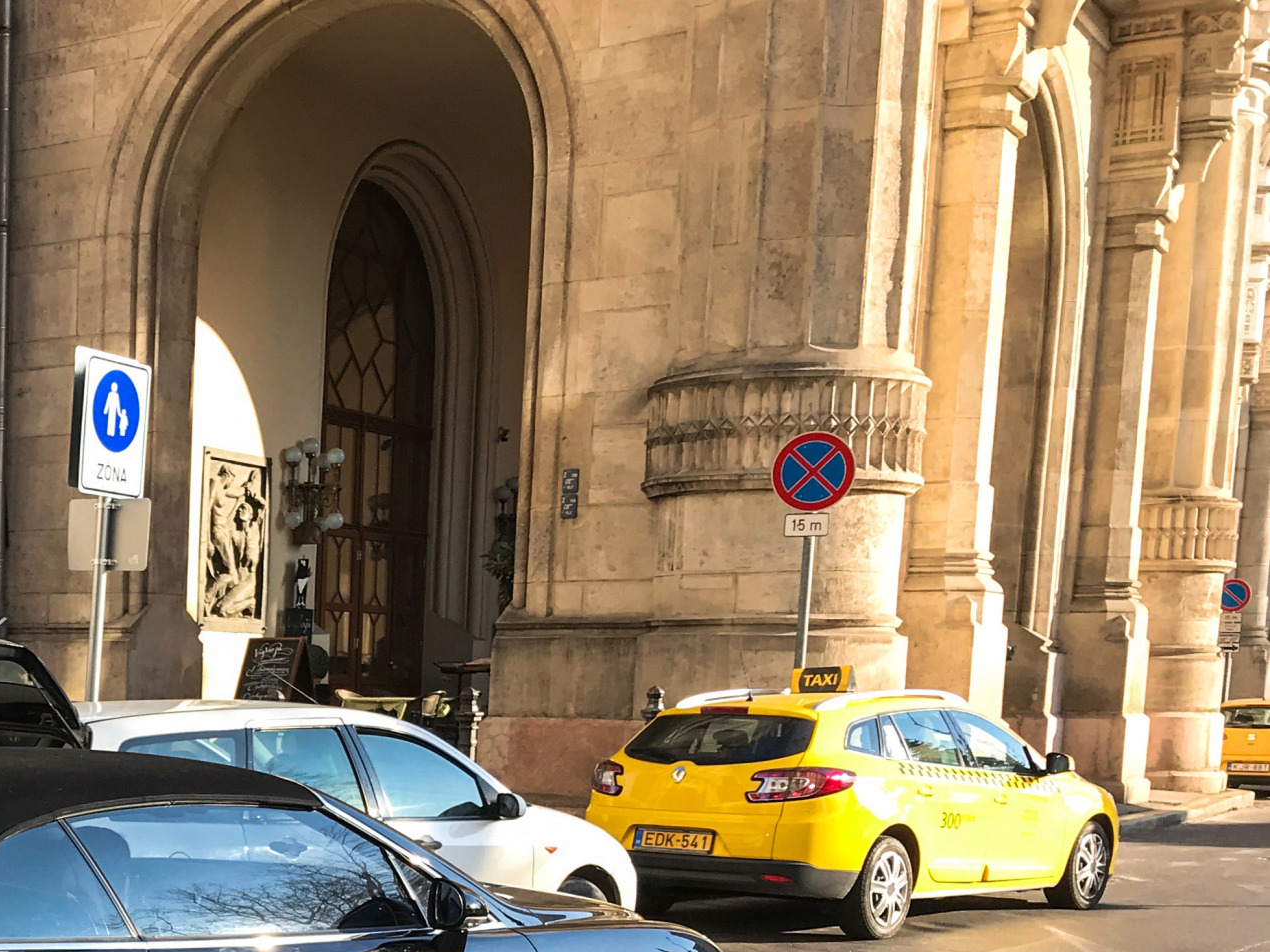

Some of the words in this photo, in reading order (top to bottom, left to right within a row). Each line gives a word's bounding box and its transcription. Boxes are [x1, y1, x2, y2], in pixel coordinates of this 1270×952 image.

[791, 519, 806, 532] 15
[809, 521, 822, 531] m
[803, 673, 839, 687] TAXI
[940, 812, 962, 830] 300
[644, 832, 708, 850] EDK-541
